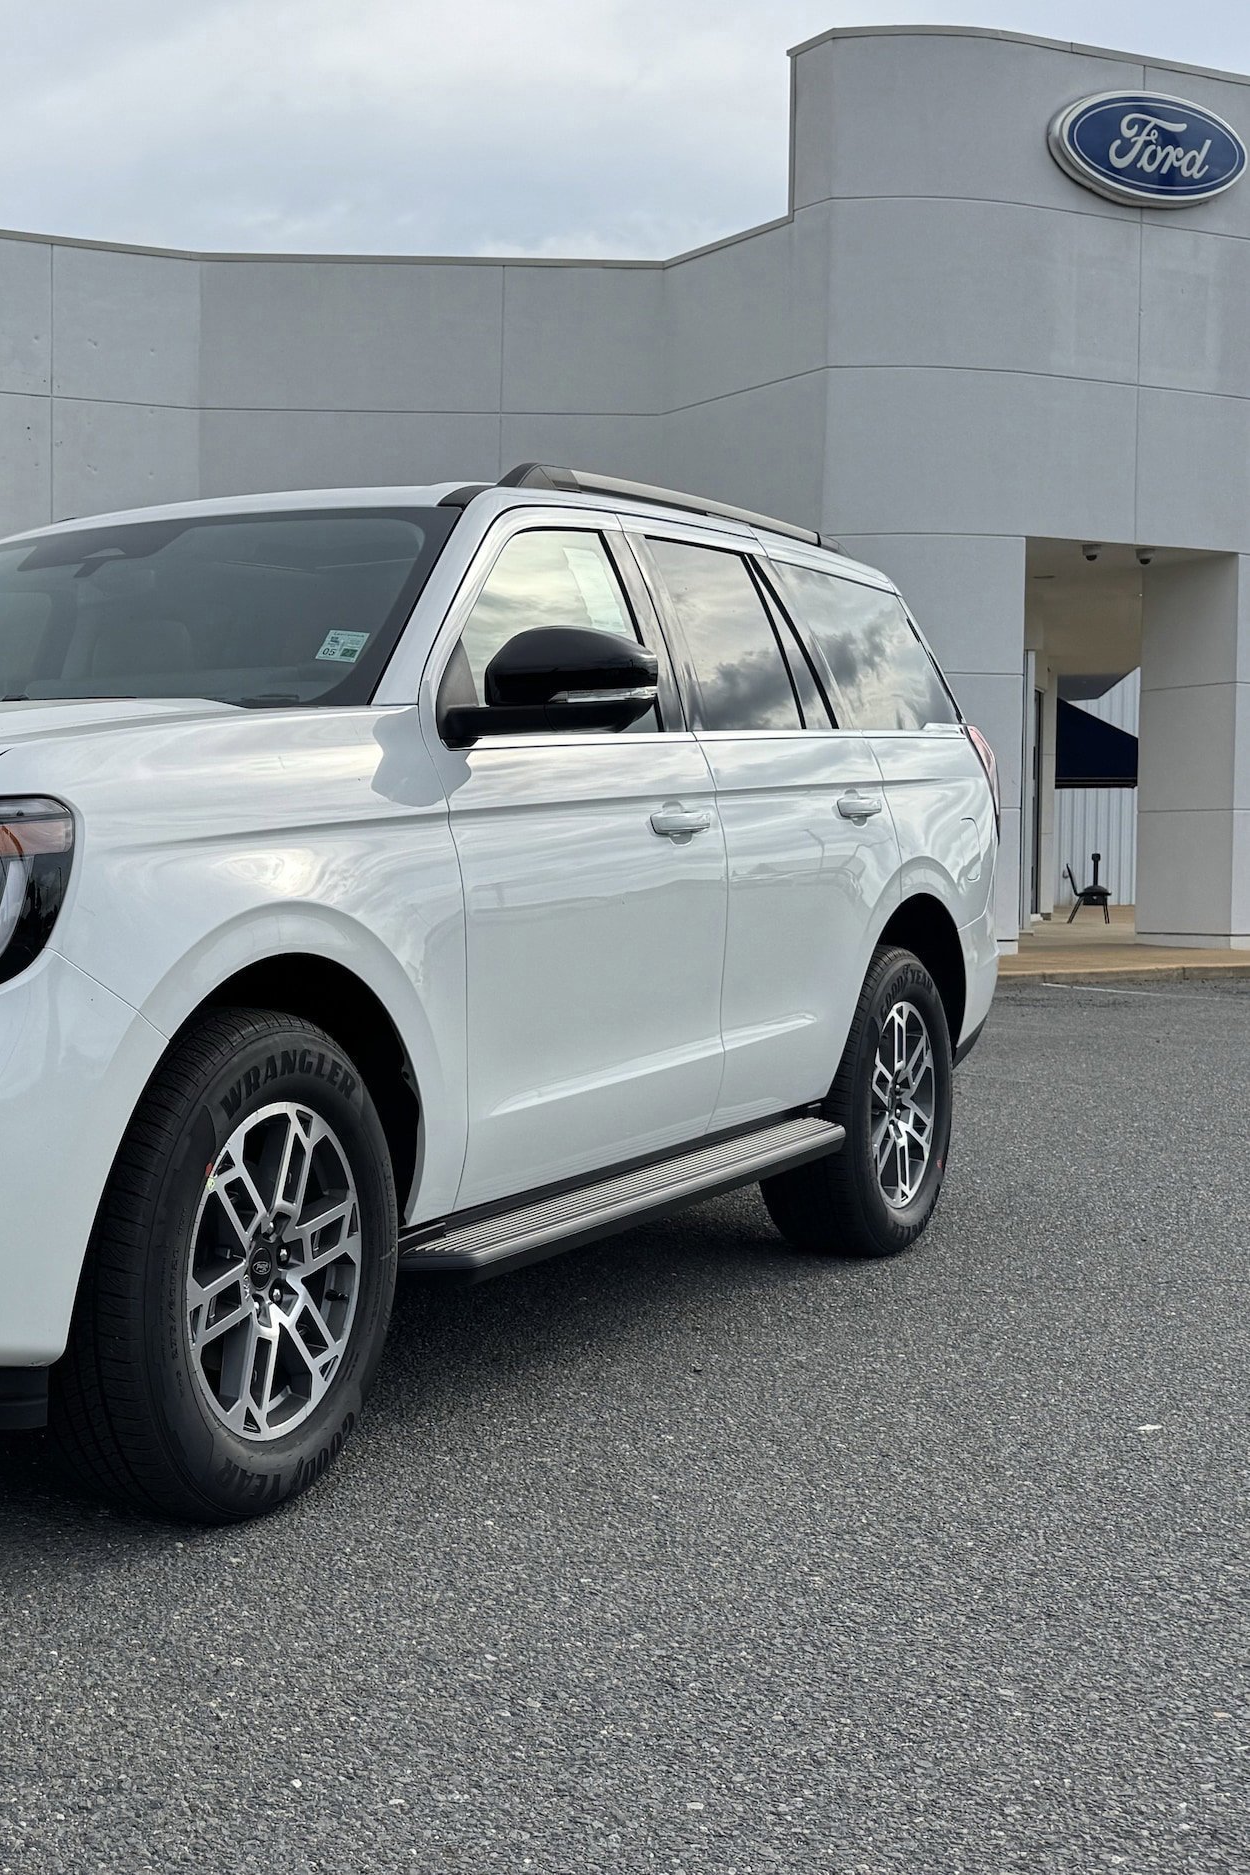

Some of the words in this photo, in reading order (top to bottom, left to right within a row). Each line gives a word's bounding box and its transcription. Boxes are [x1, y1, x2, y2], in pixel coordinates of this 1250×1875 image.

[1108, 113, 1212, 180] Ford
[322, 648, 336, 656] 05
[219, 1049, 357, 1120] WRANGLER
